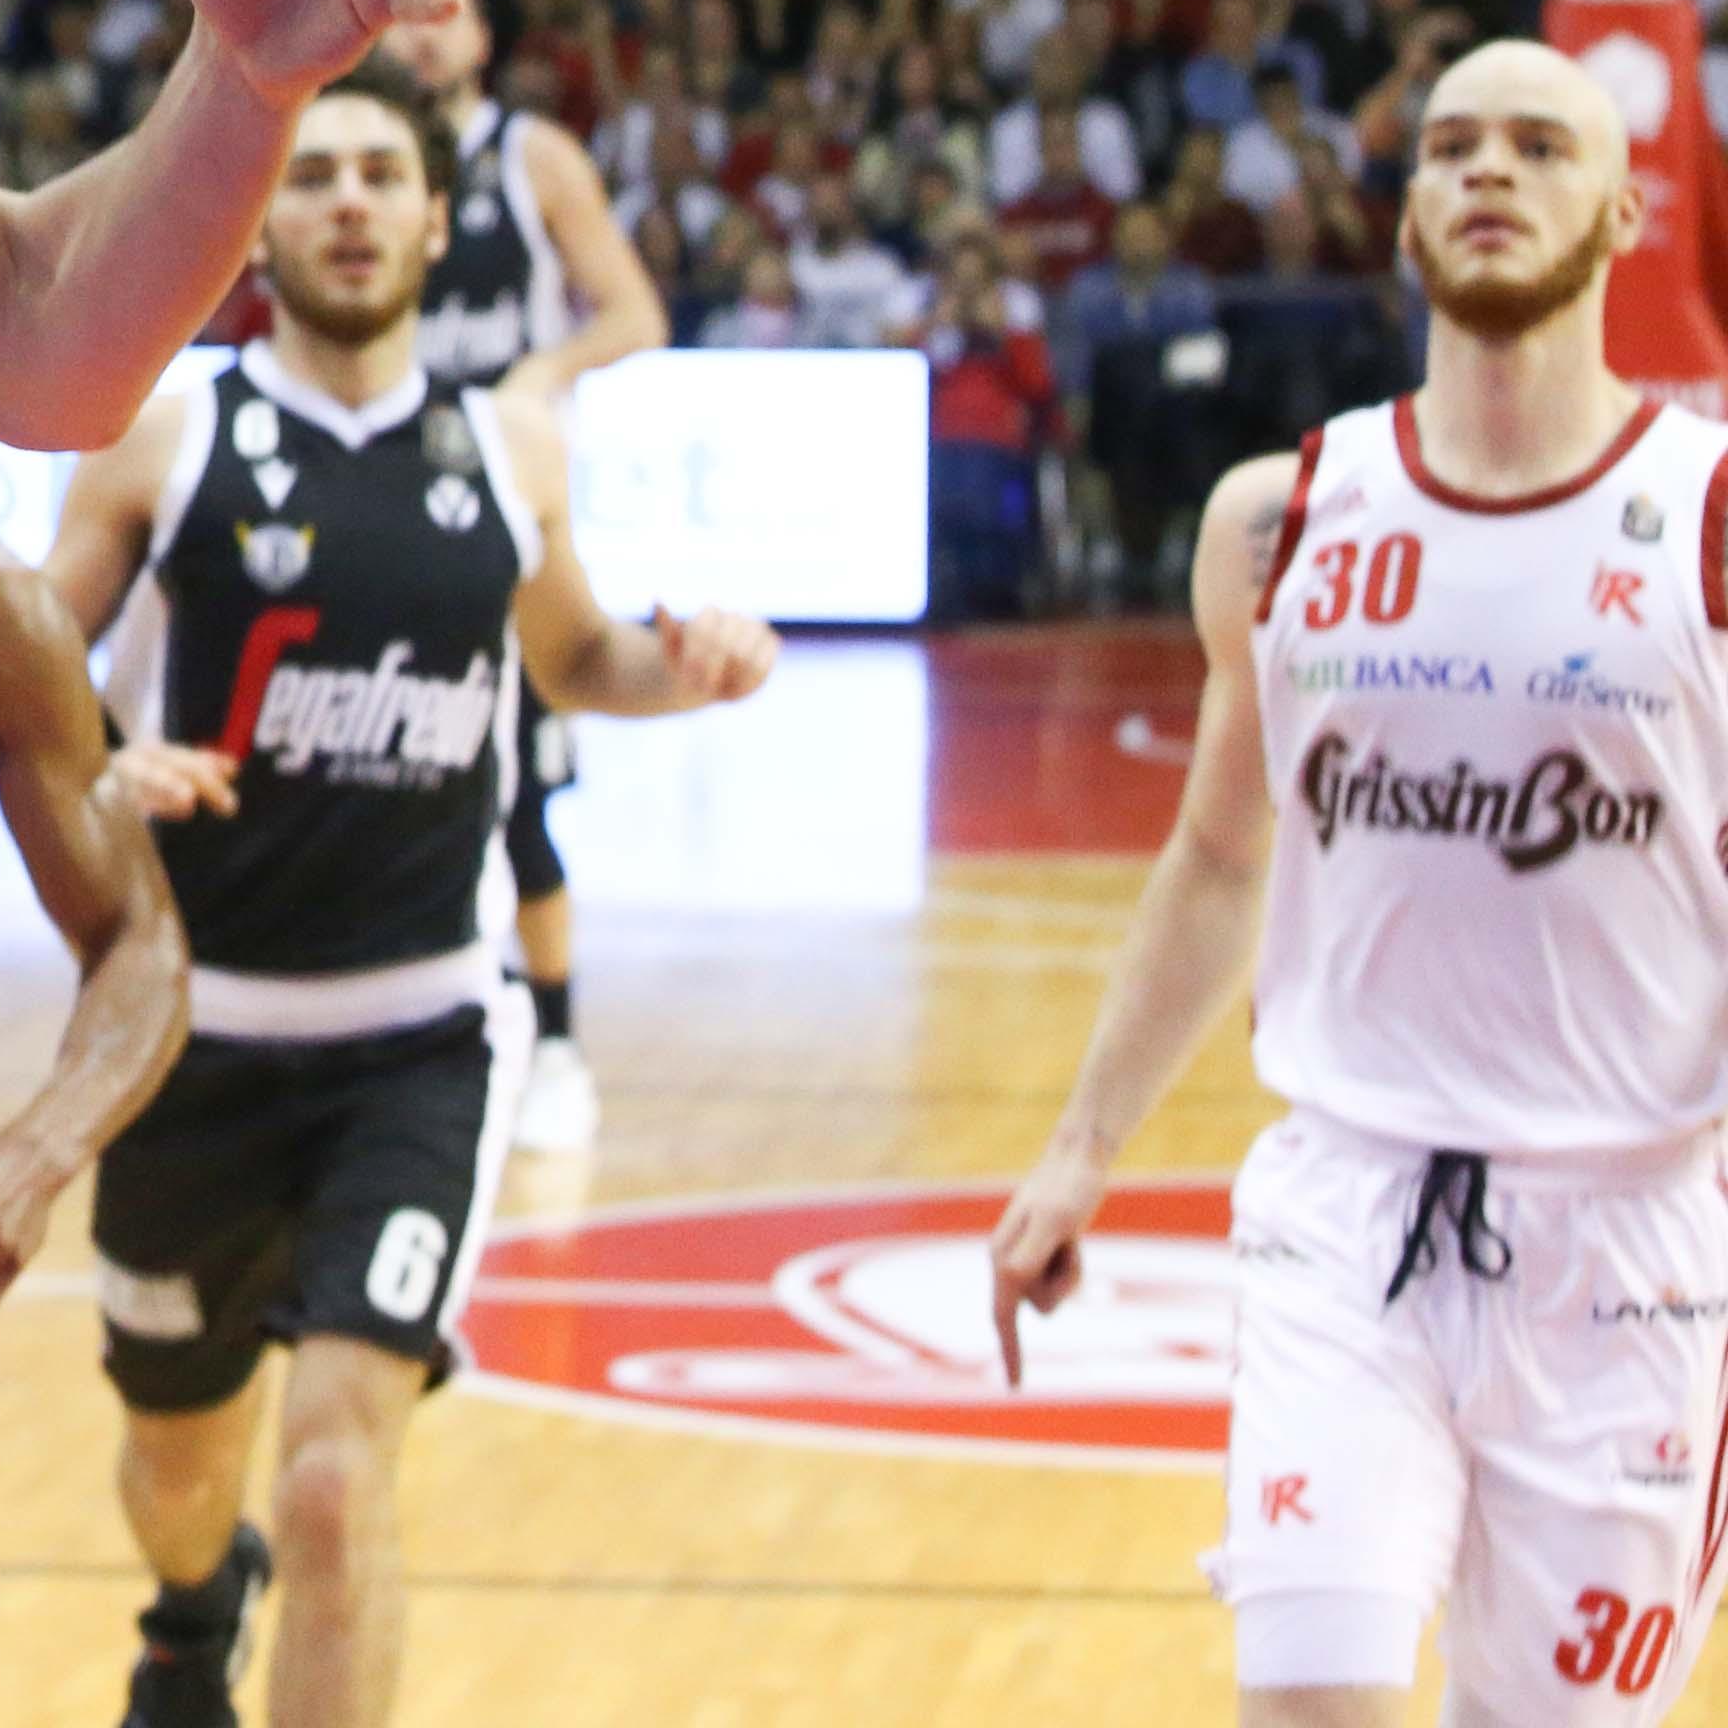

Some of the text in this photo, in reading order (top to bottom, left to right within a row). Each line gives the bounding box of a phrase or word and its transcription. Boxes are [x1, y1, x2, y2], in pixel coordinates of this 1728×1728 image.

[1304, 533, 1423, 631] 30
[1286, 654, 1495, 695] MILBANCA
[1299, 730, 1666, 877] GrissinBon
[366, 1208, 447, 1324] 6
[1554, 1588, 1675, 1697] 30
